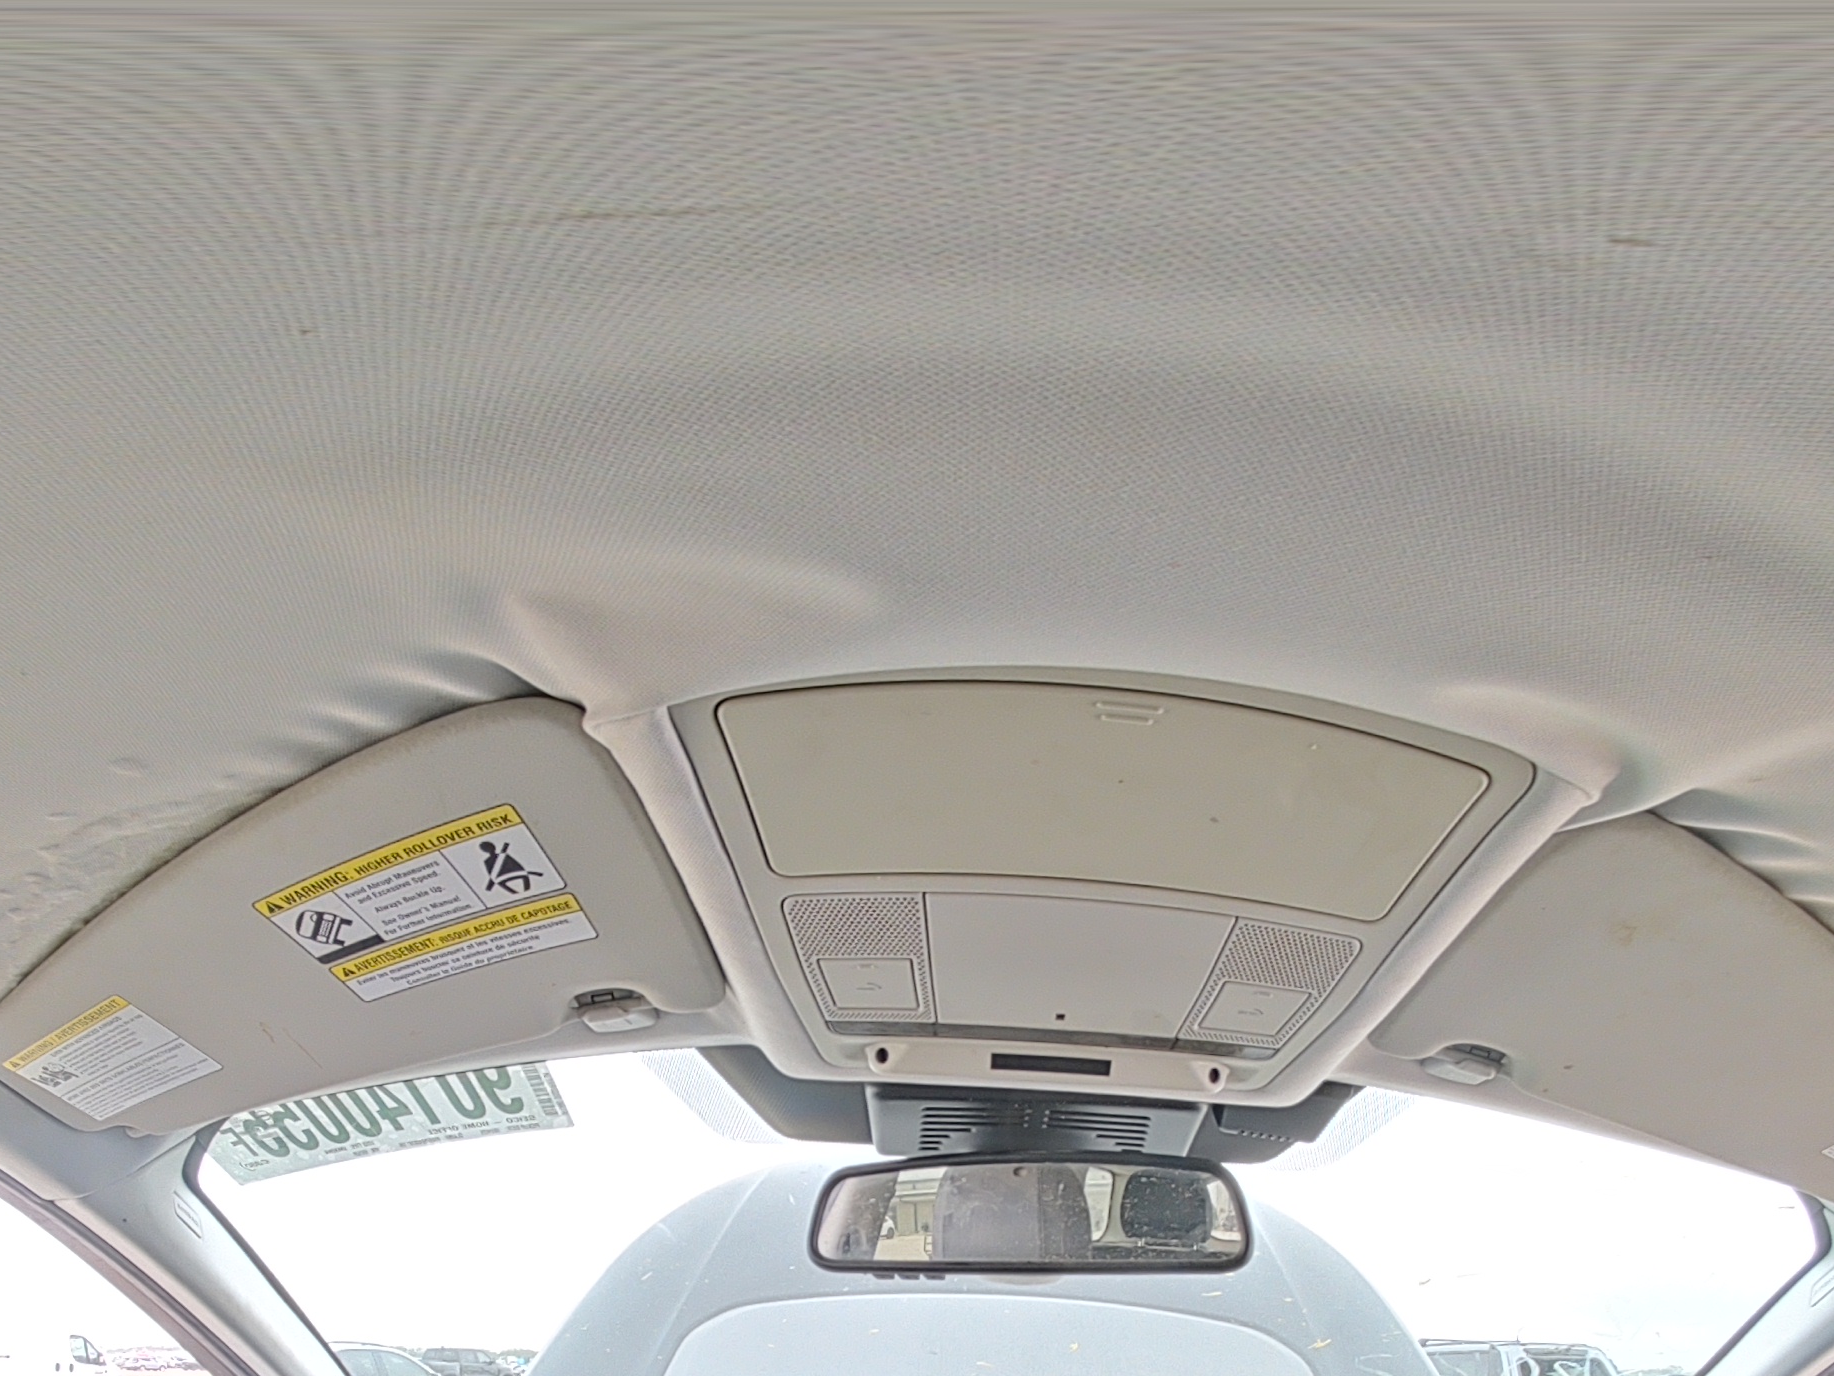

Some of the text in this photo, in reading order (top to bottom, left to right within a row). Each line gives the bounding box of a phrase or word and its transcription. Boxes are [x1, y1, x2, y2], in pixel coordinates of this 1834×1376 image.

[279, 814, 514, 906] WARNING: HIGHER ROLLOVER RISK
[354, 900, 575, 973] AVERTISSEMENT: RISQUE ACCRU DE CAPOTAGE
[54, 999, 122, 1041] AVERTISSEMENT
